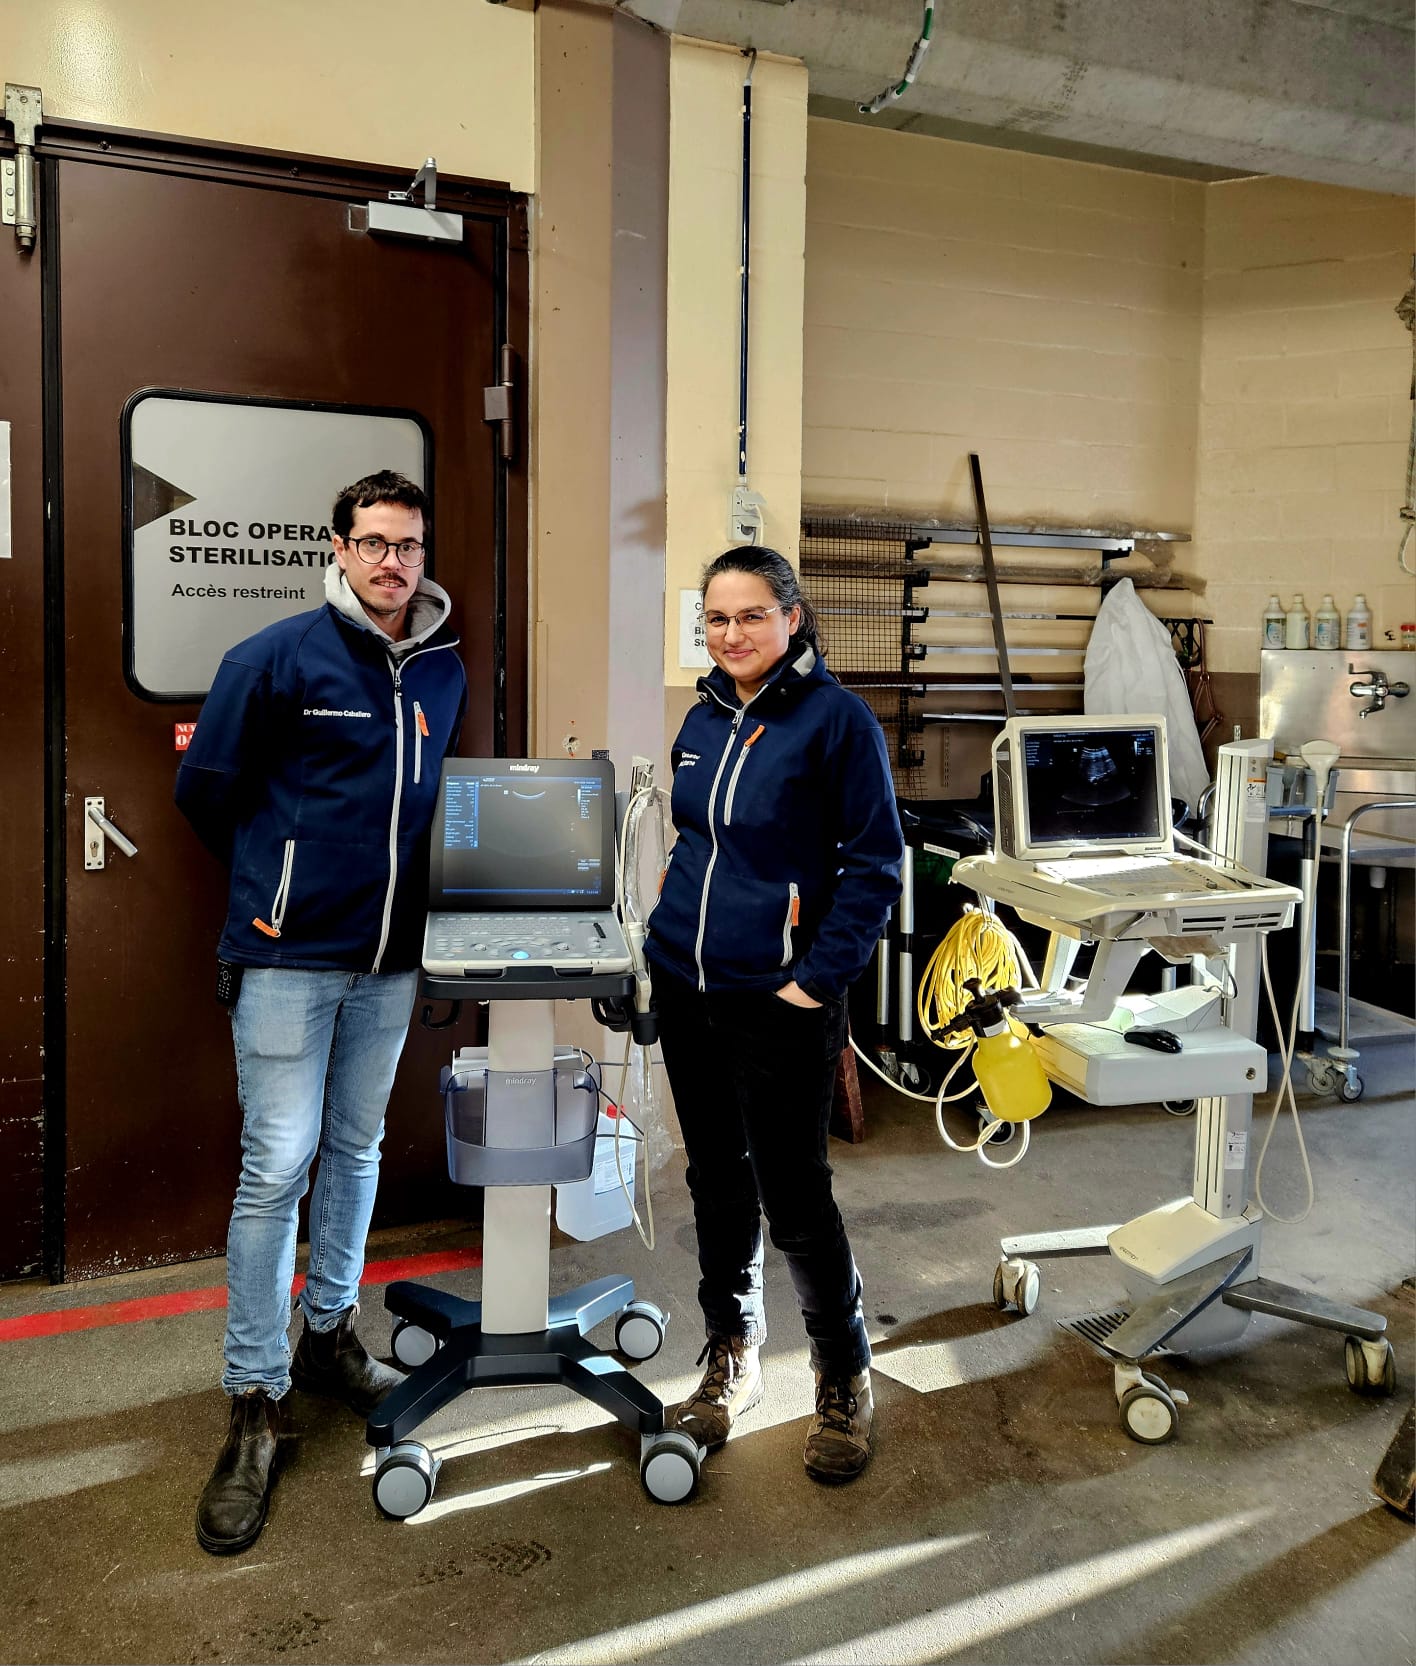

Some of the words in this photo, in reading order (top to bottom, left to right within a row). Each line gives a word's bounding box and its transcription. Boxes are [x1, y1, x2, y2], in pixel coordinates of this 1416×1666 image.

[169, 519, 239, 538] BLOC
[248, 522, 336, 542] OPERA
[171, 583, 227, 598] Accès
[233, 586, 306, 599] restreint
[509, 763, 540, 774] mindray
[505, 1077, 537, 1086] mindray
